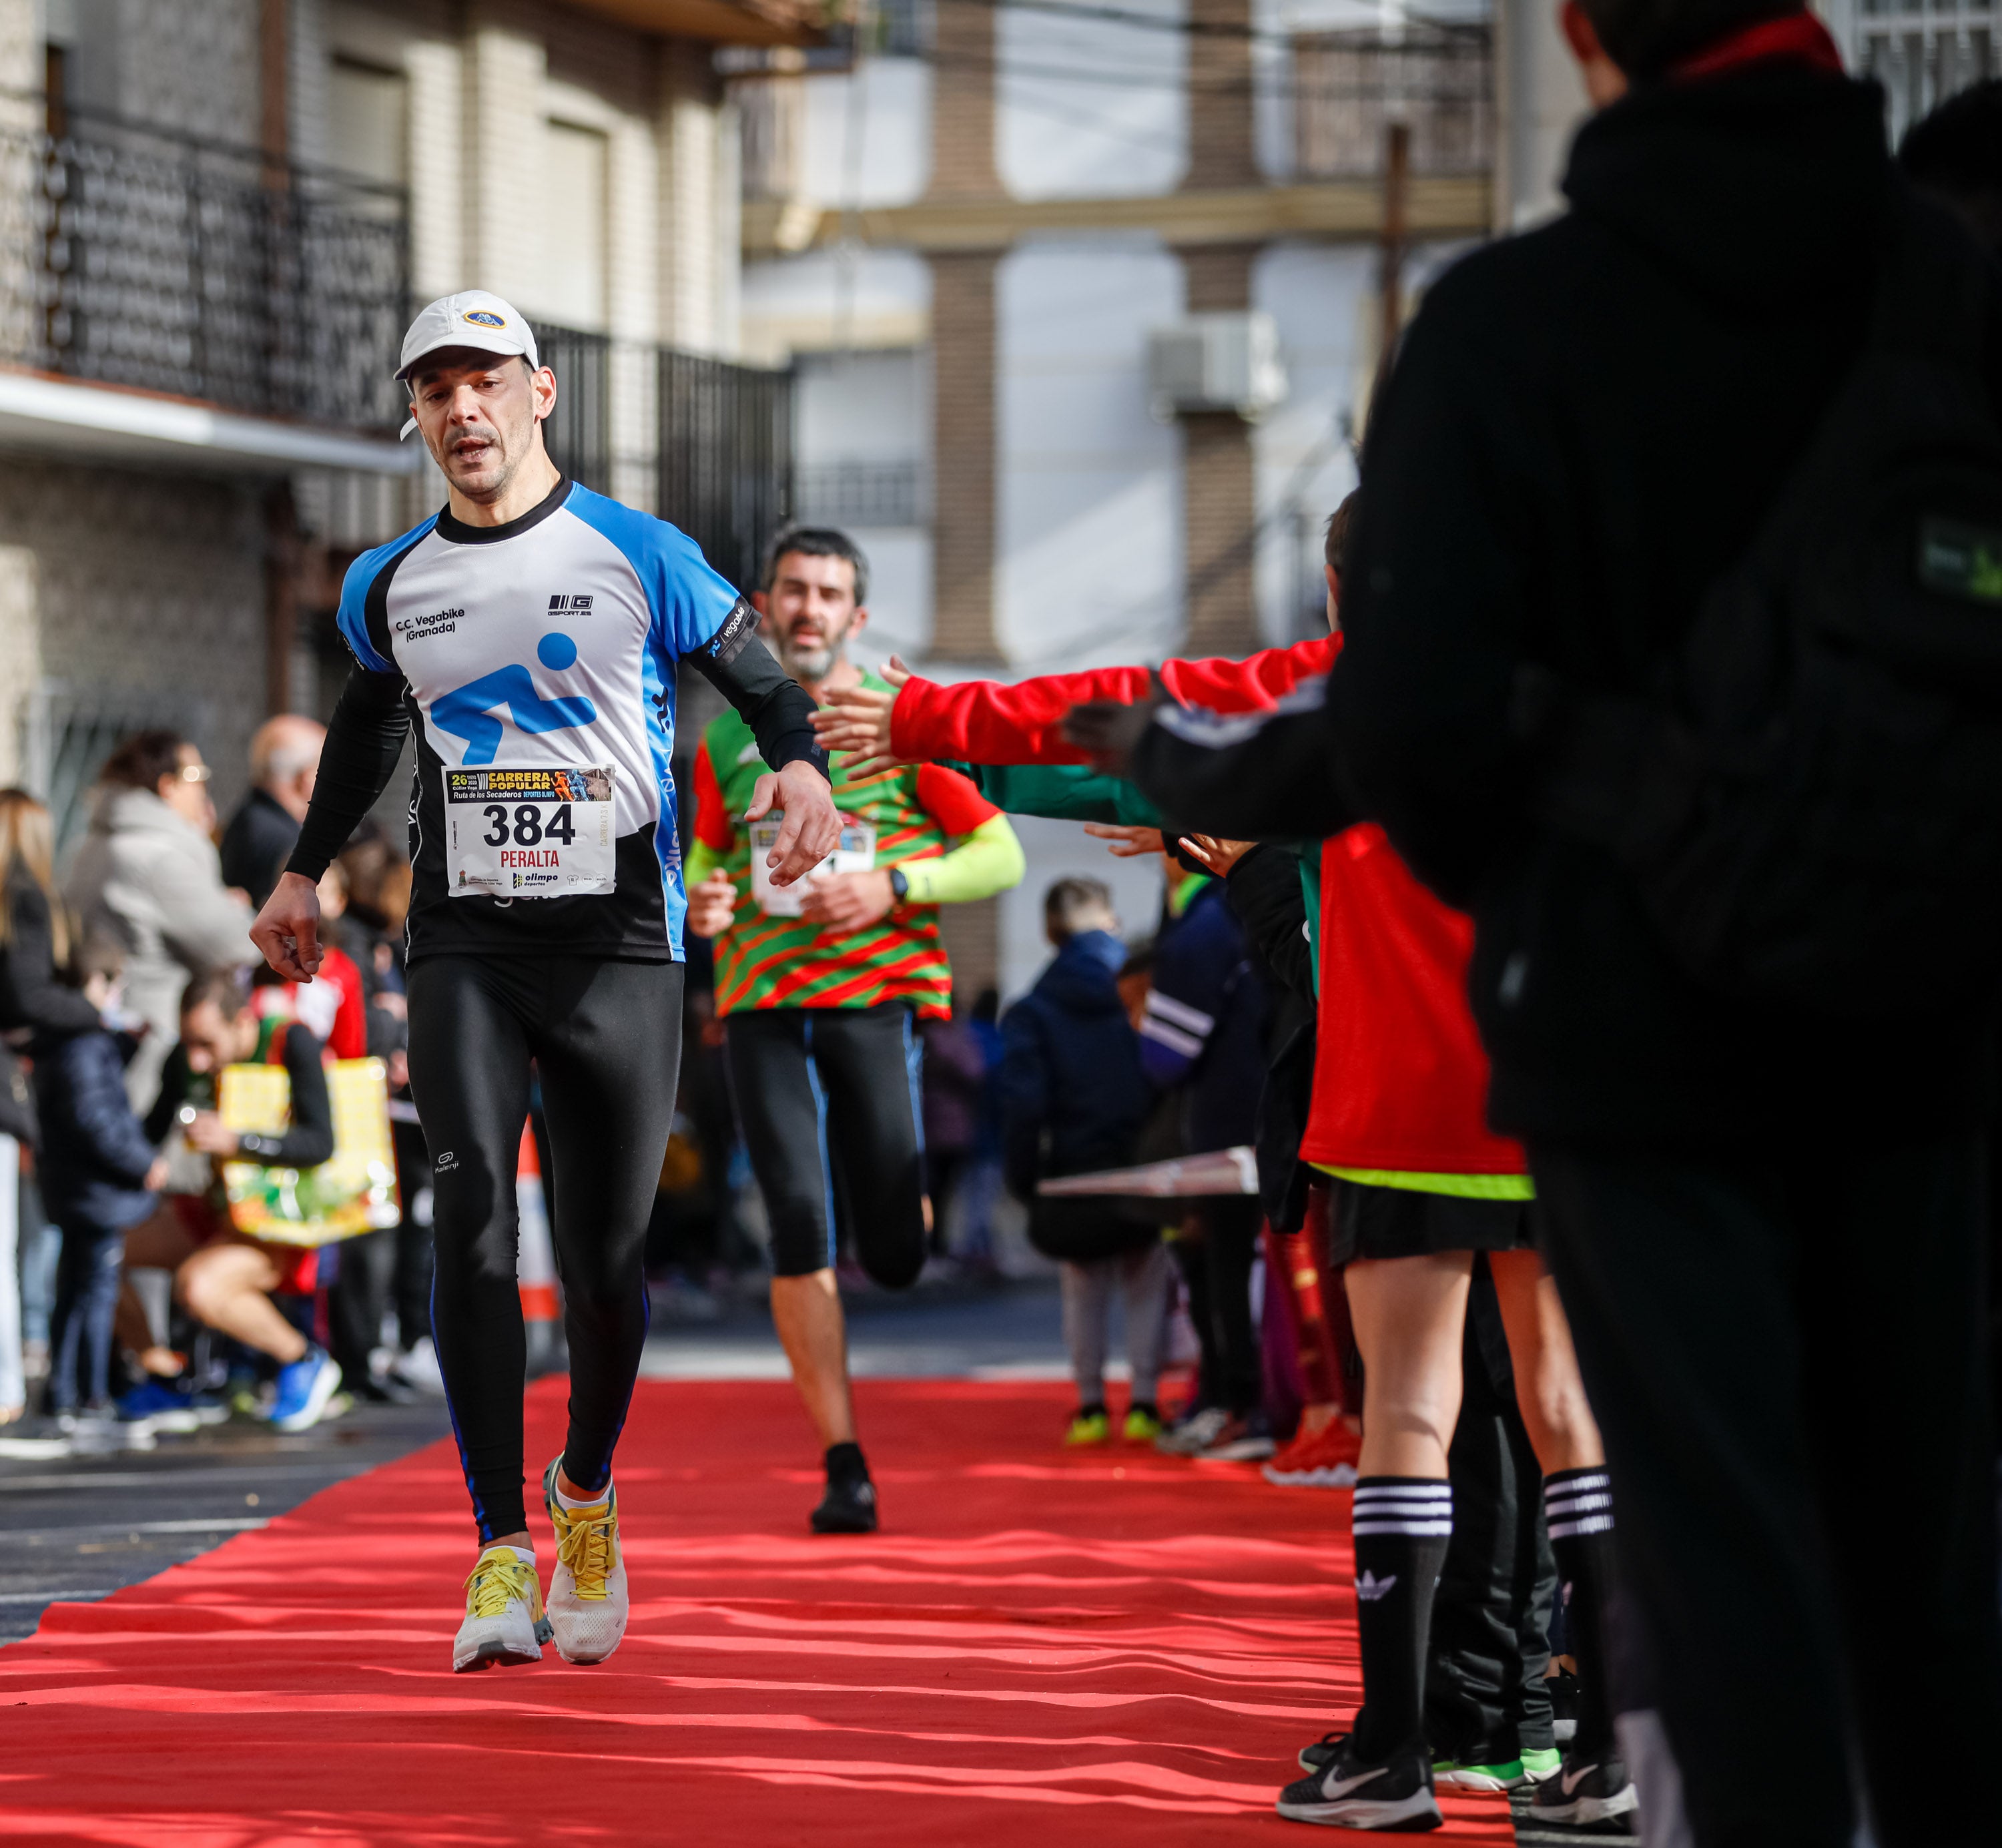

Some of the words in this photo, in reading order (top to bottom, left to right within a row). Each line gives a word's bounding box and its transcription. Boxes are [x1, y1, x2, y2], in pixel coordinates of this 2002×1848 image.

[396, 619, 414, 631] C.C.
[415, 608, 465, 626] Vegabike
[406, 621, 456, 643] (Granada)
[452, 774, 468, 786] 26
[476, 773, 488, 790] VII
[488, 772, 551, 782] CARRERA
[488, 782, 551, 790] POPULAR
[482, 804, 576, 847] 384
[600, 820, 609, 846] CARRERA
[500, 850, 559, 868] PERALTA
[525, 873, 559, 882] olimpo
[434, 1161, 459, 1174] Kalenji
